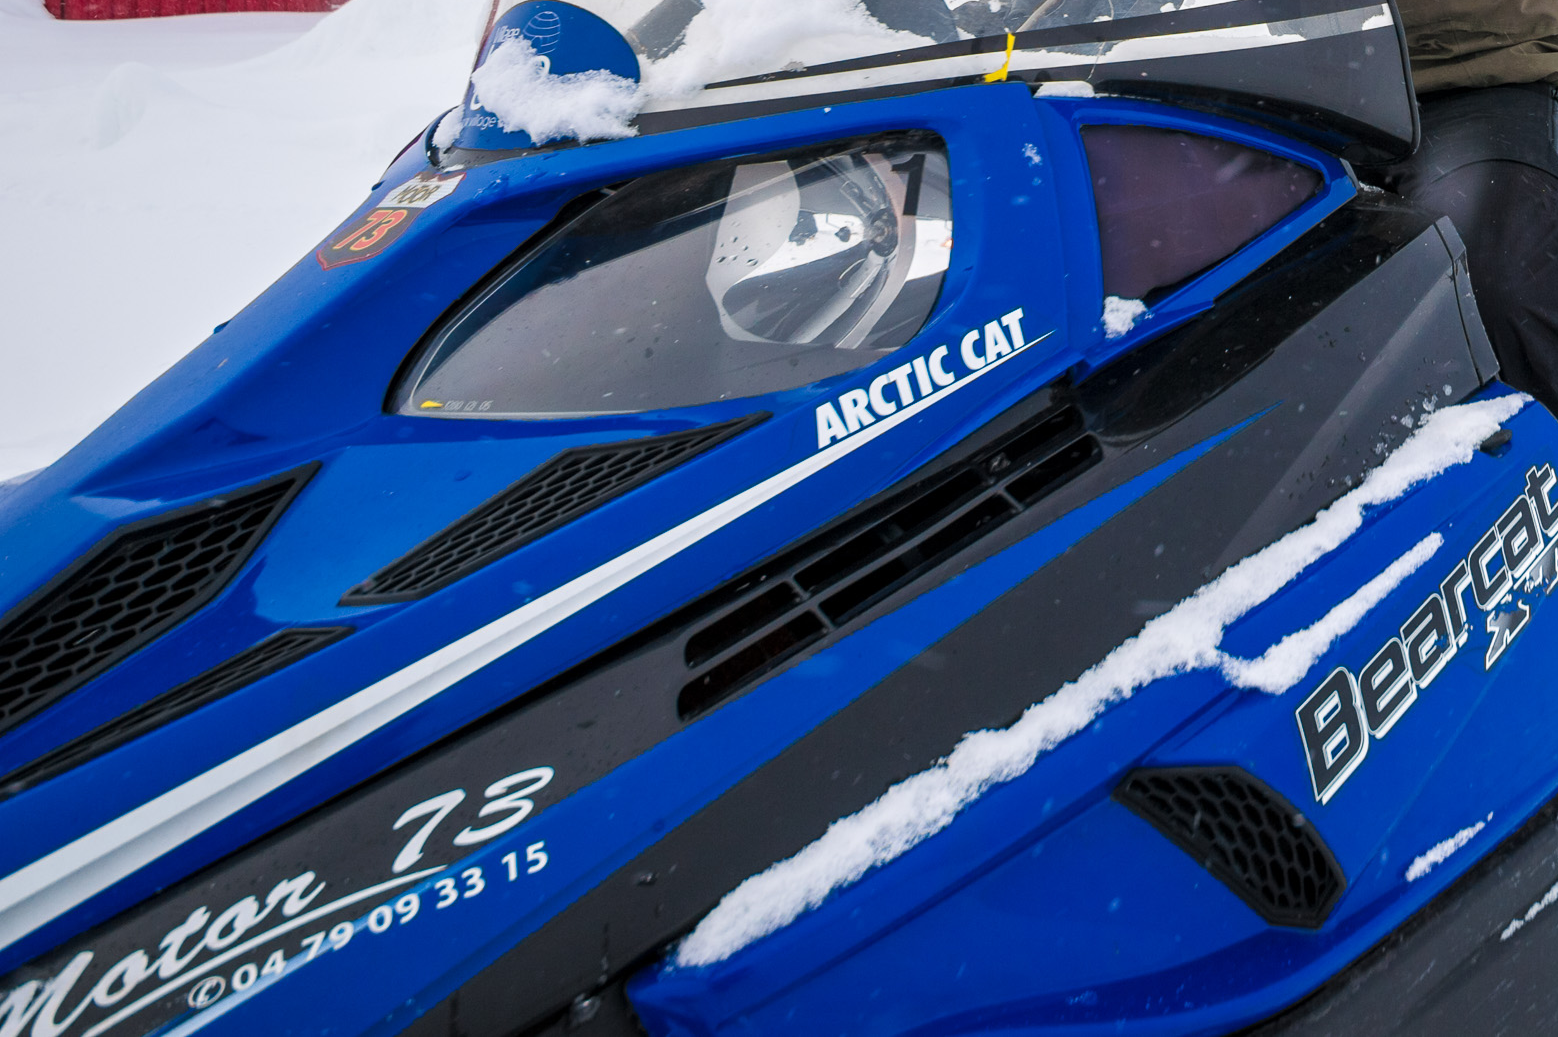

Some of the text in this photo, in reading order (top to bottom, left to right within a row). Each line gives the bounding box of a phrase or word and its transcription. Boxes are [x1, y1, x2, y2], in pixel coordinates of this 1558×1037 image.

[332, 209, 408, 251] 73
[815, 307, 1025, 450] ARCTIC CAT
[390, 765, 555, 874] 73
[231, 840, 549, 992] 04 79 09 33 15
